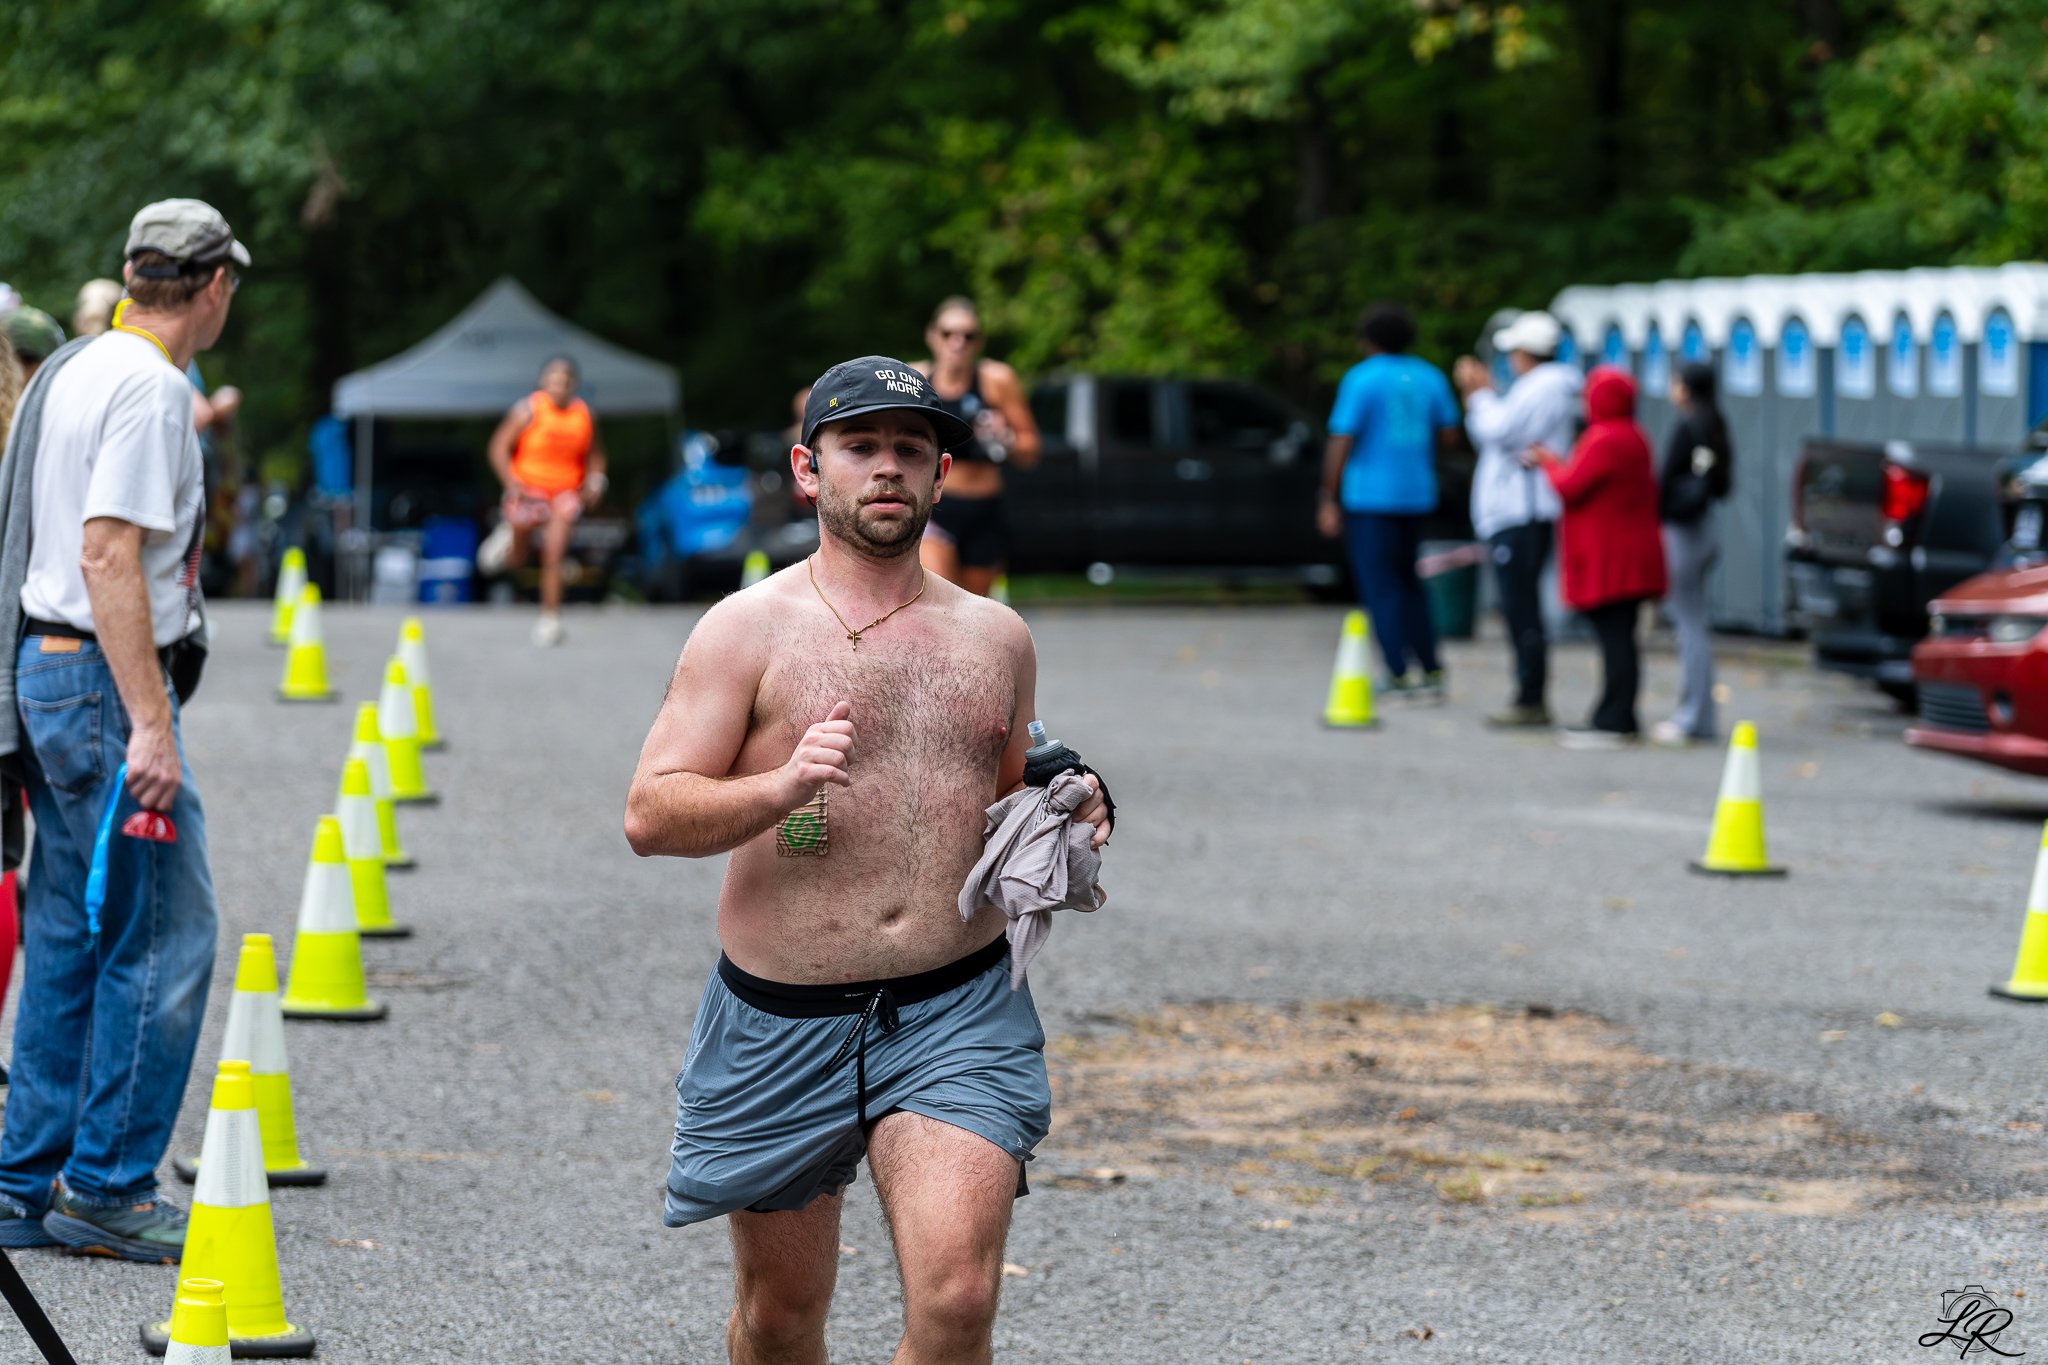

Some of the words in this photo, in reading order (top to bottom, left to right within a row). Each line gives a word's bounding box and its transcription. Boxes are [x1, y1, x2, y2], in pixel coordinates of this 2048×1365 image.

[875, 370, 896, 380] GO
[899, 372, 923, 391] ONE
[887, 380, 921, 398] MORE
